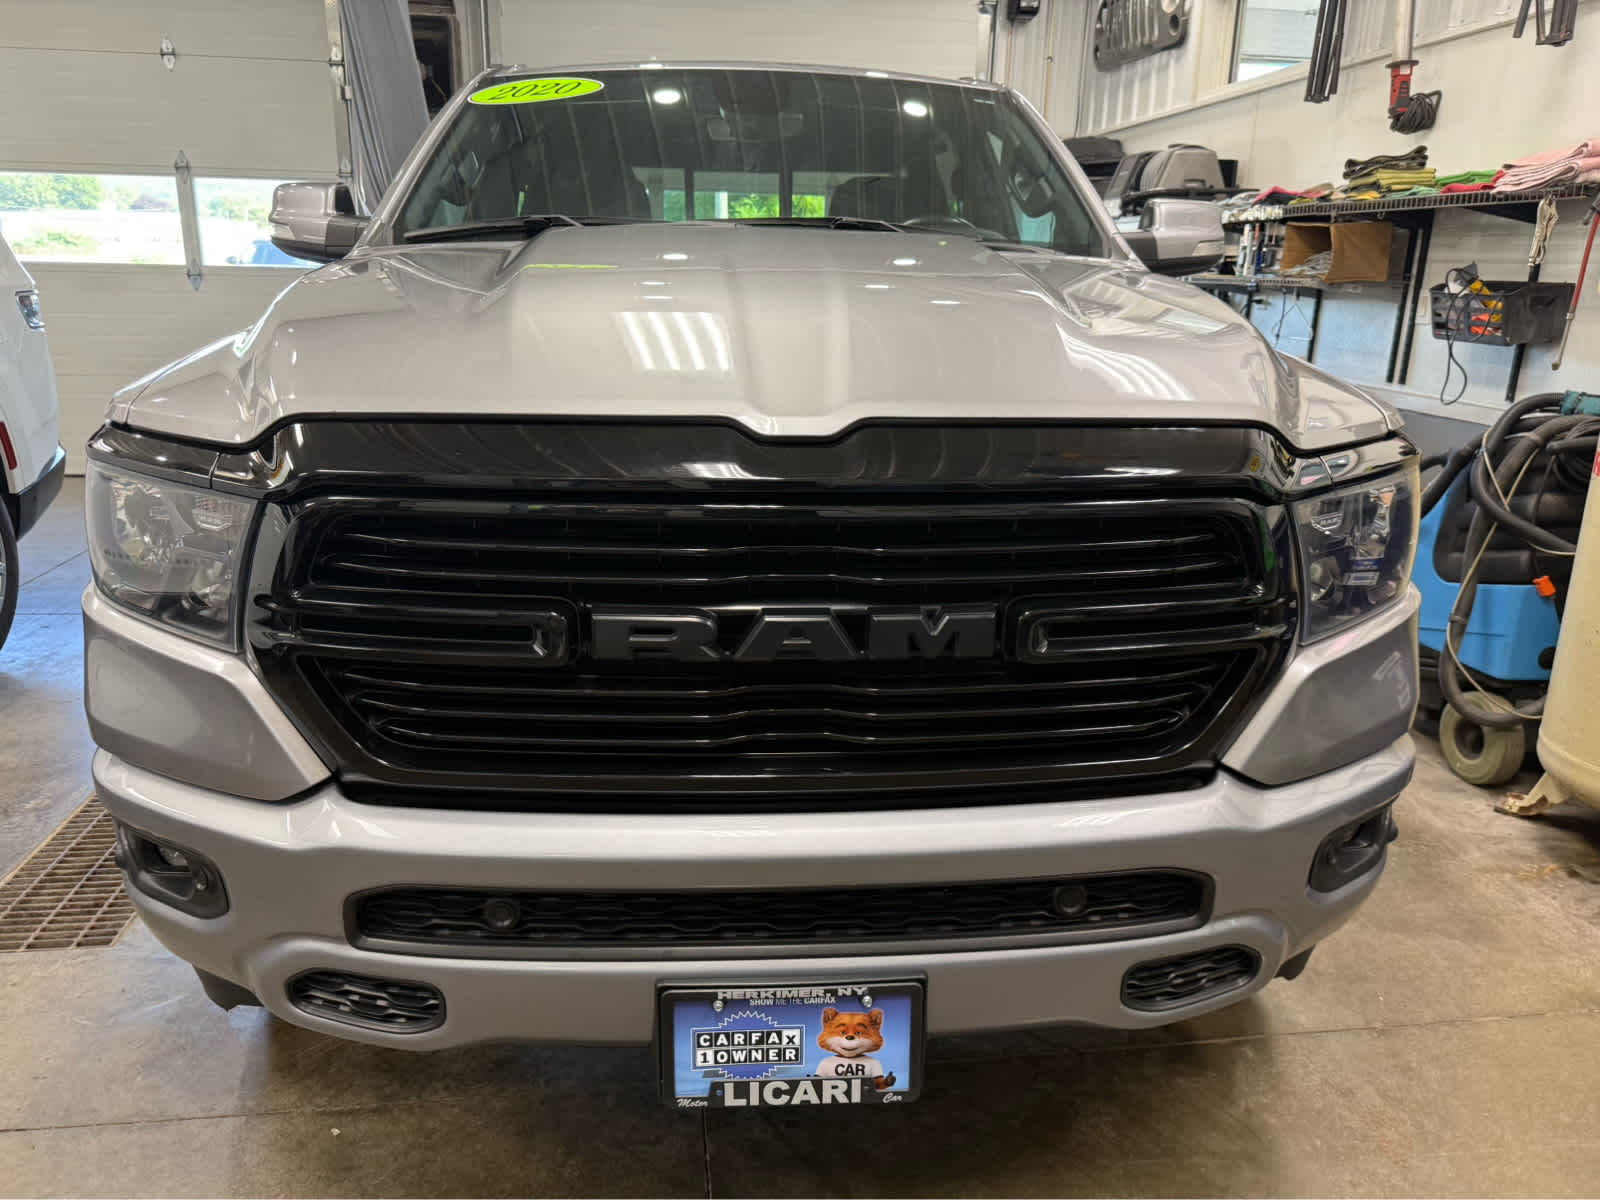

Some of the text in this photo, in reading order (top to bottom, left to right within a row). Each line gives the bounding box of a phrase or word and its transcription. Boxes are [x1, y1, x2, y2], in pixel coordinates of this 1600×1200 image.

[487, 81, 582, 101] 2020
[591, 604, 997, 661] RAM
[717, 985, 868, 1000] HERKIMER, NY
[699, 1032, 797, 1047] CARFAX
[834, 1063, 866, 1077] CAR
[724, 1079, 862, 1107] LICARI
[882, 1092, 903, 1104] Car
